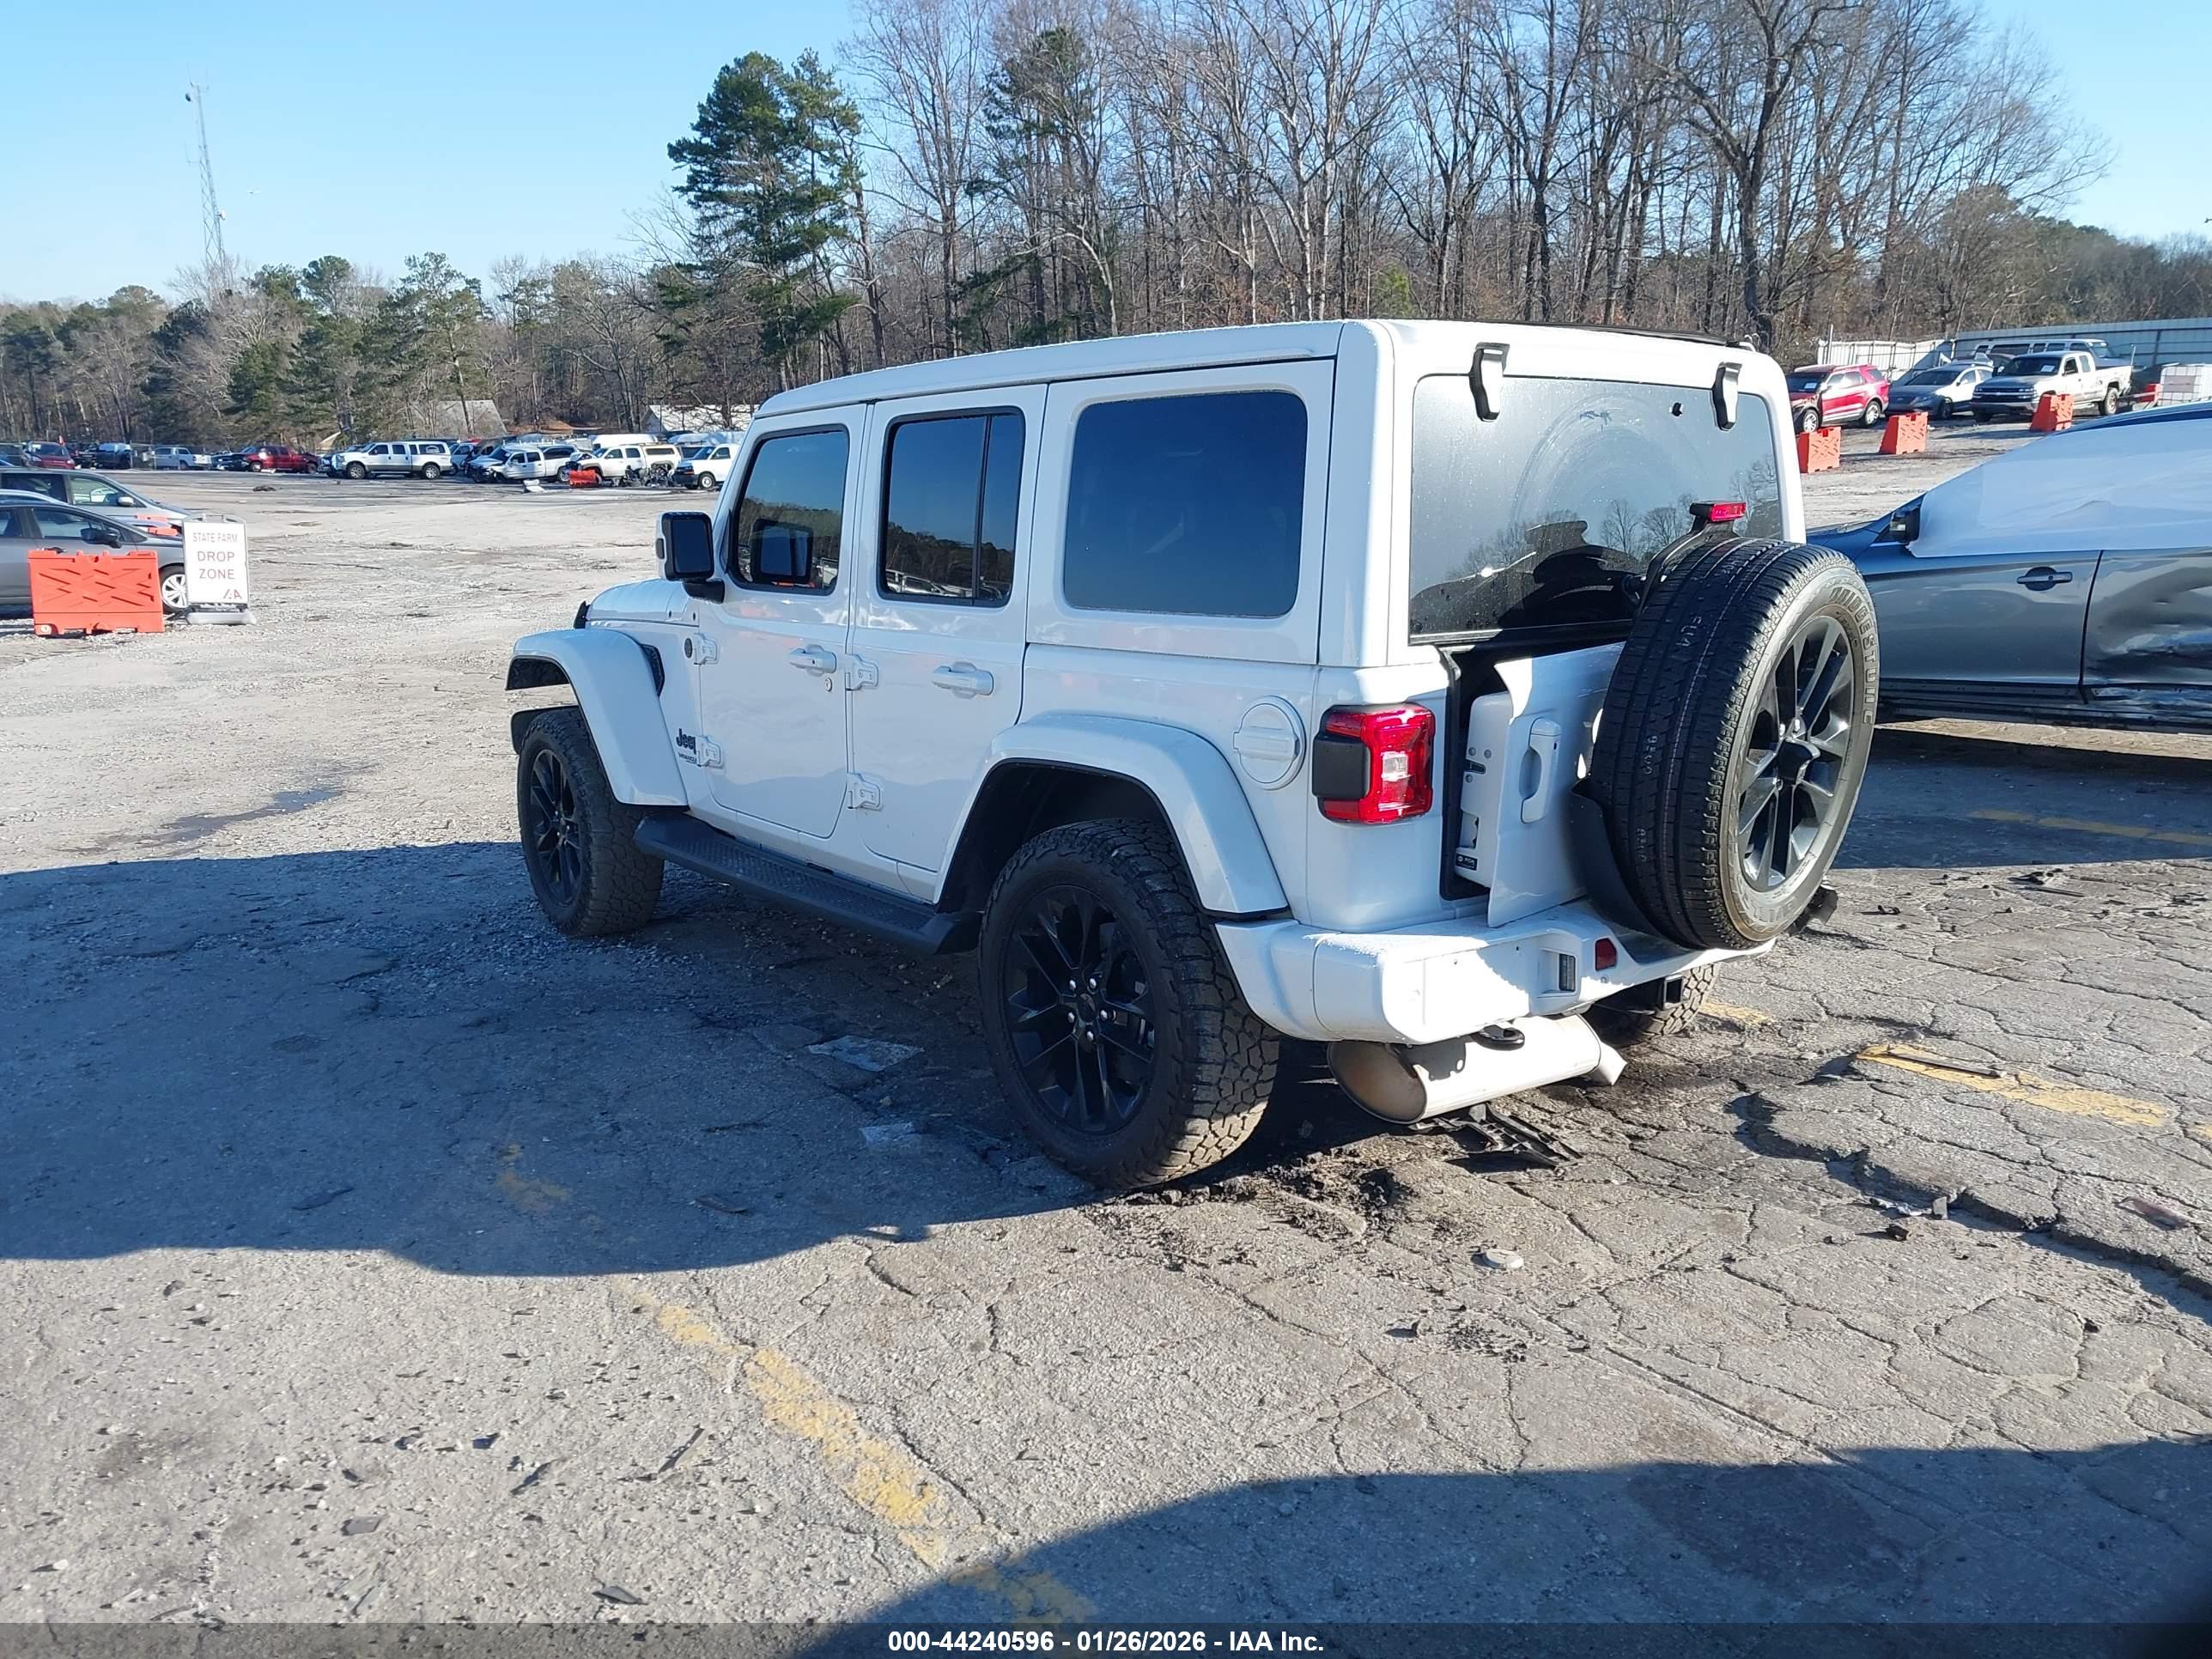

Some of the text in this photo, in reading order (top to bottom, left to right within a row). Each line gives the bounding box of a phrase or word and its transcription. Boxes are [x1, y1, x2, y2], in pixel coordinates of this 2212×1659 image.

[192, 532, 239, 543] STATE FARM
[197, 550, 235, 562] DROP
[198, 568, 234, 580] ZONE
